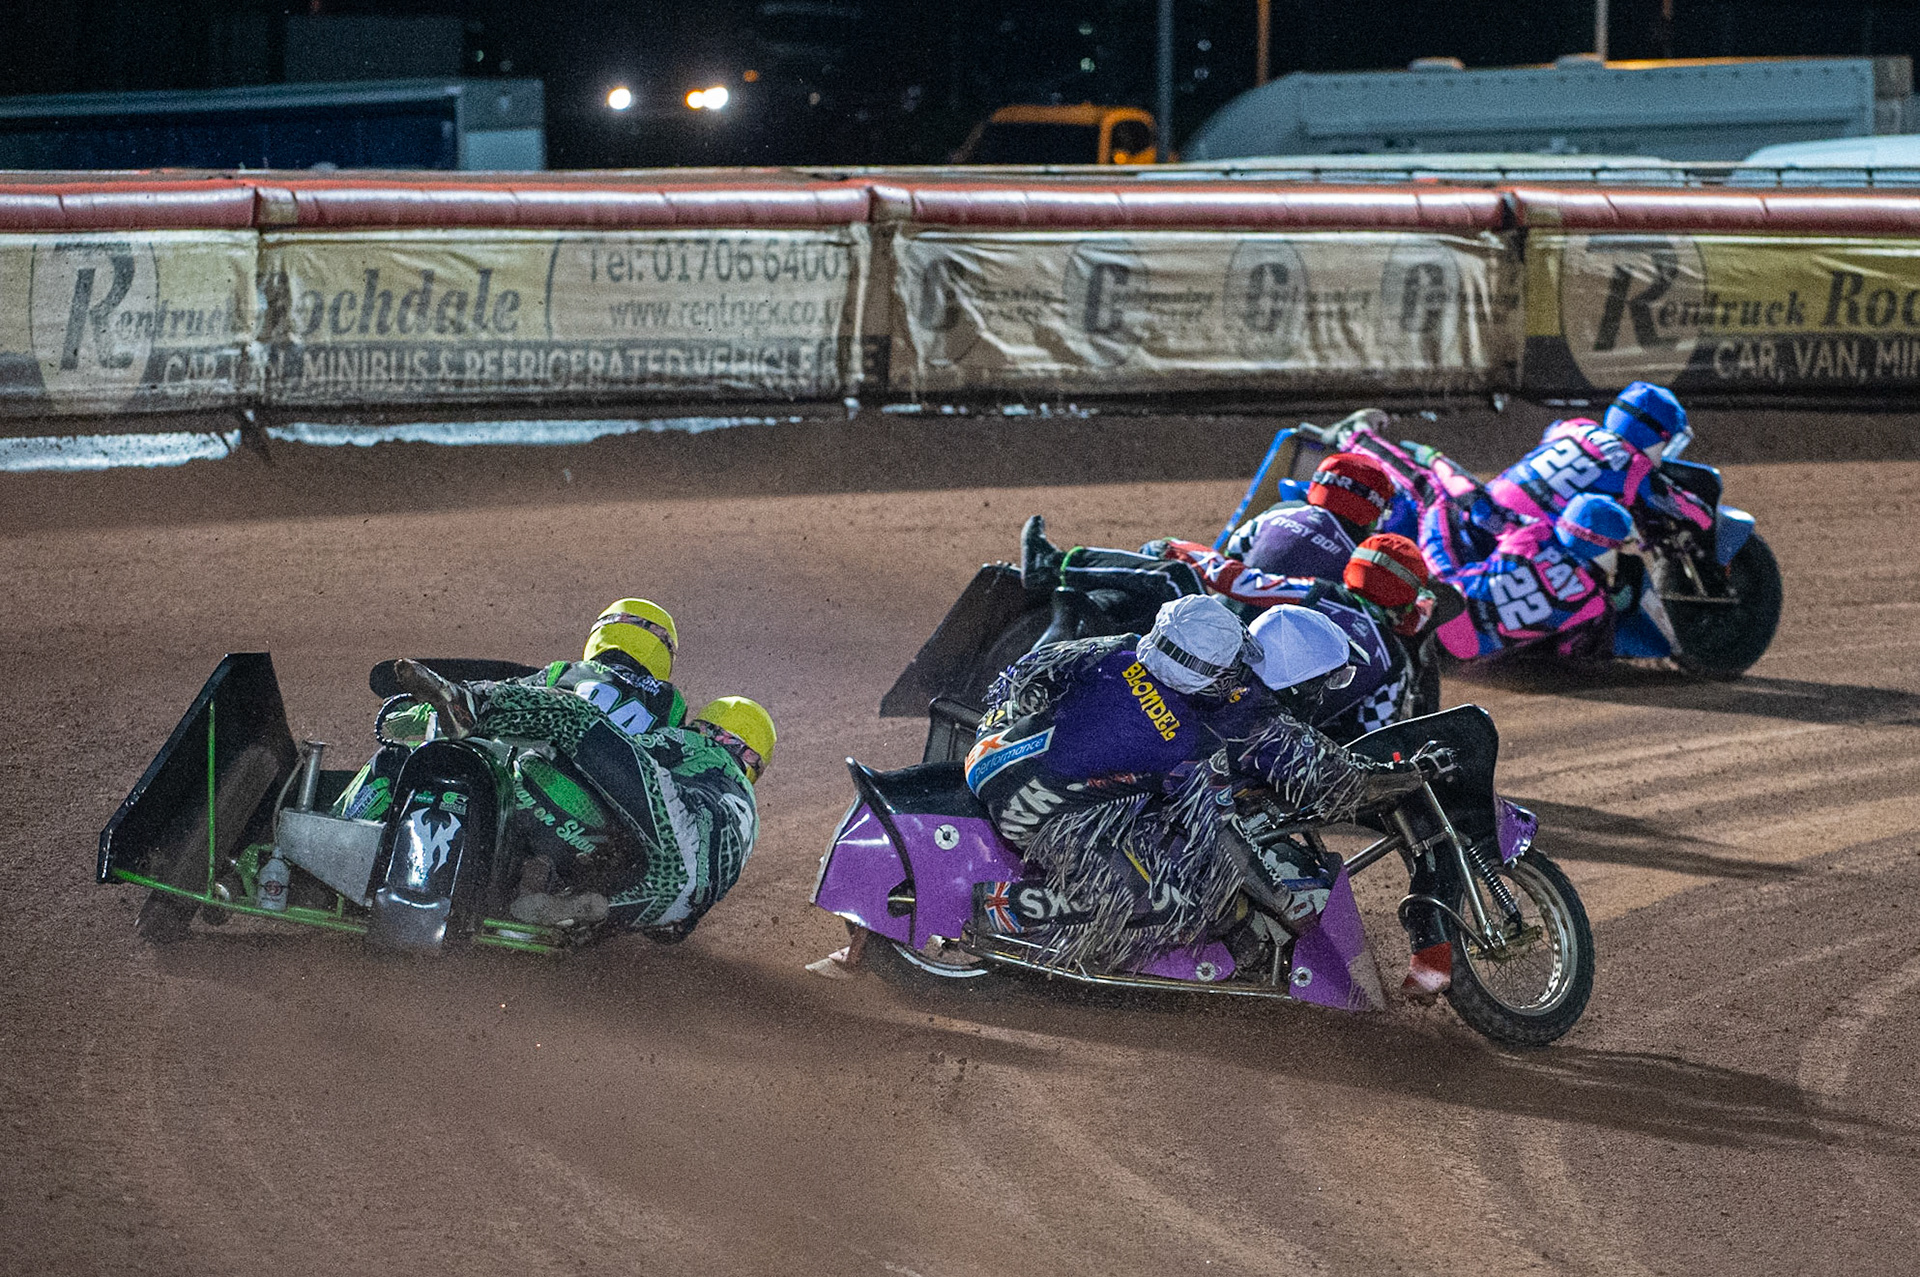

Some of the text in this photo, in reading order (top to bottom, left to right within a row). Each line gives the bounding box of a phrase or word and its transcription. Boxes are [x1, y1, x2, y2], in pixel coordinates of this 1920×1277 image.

[262, 268, 520, 336] ochdale
[1713, 341, 1787, 385] CAR,
[1793, 341, 1869, 385] VAN,
[1529, 438, 1602, 500] 22
[1489, 565, 1553, 631] 22
[1122, 661, 1181, 742] BLONDEL
[974, 737, 1045, 785] performance
